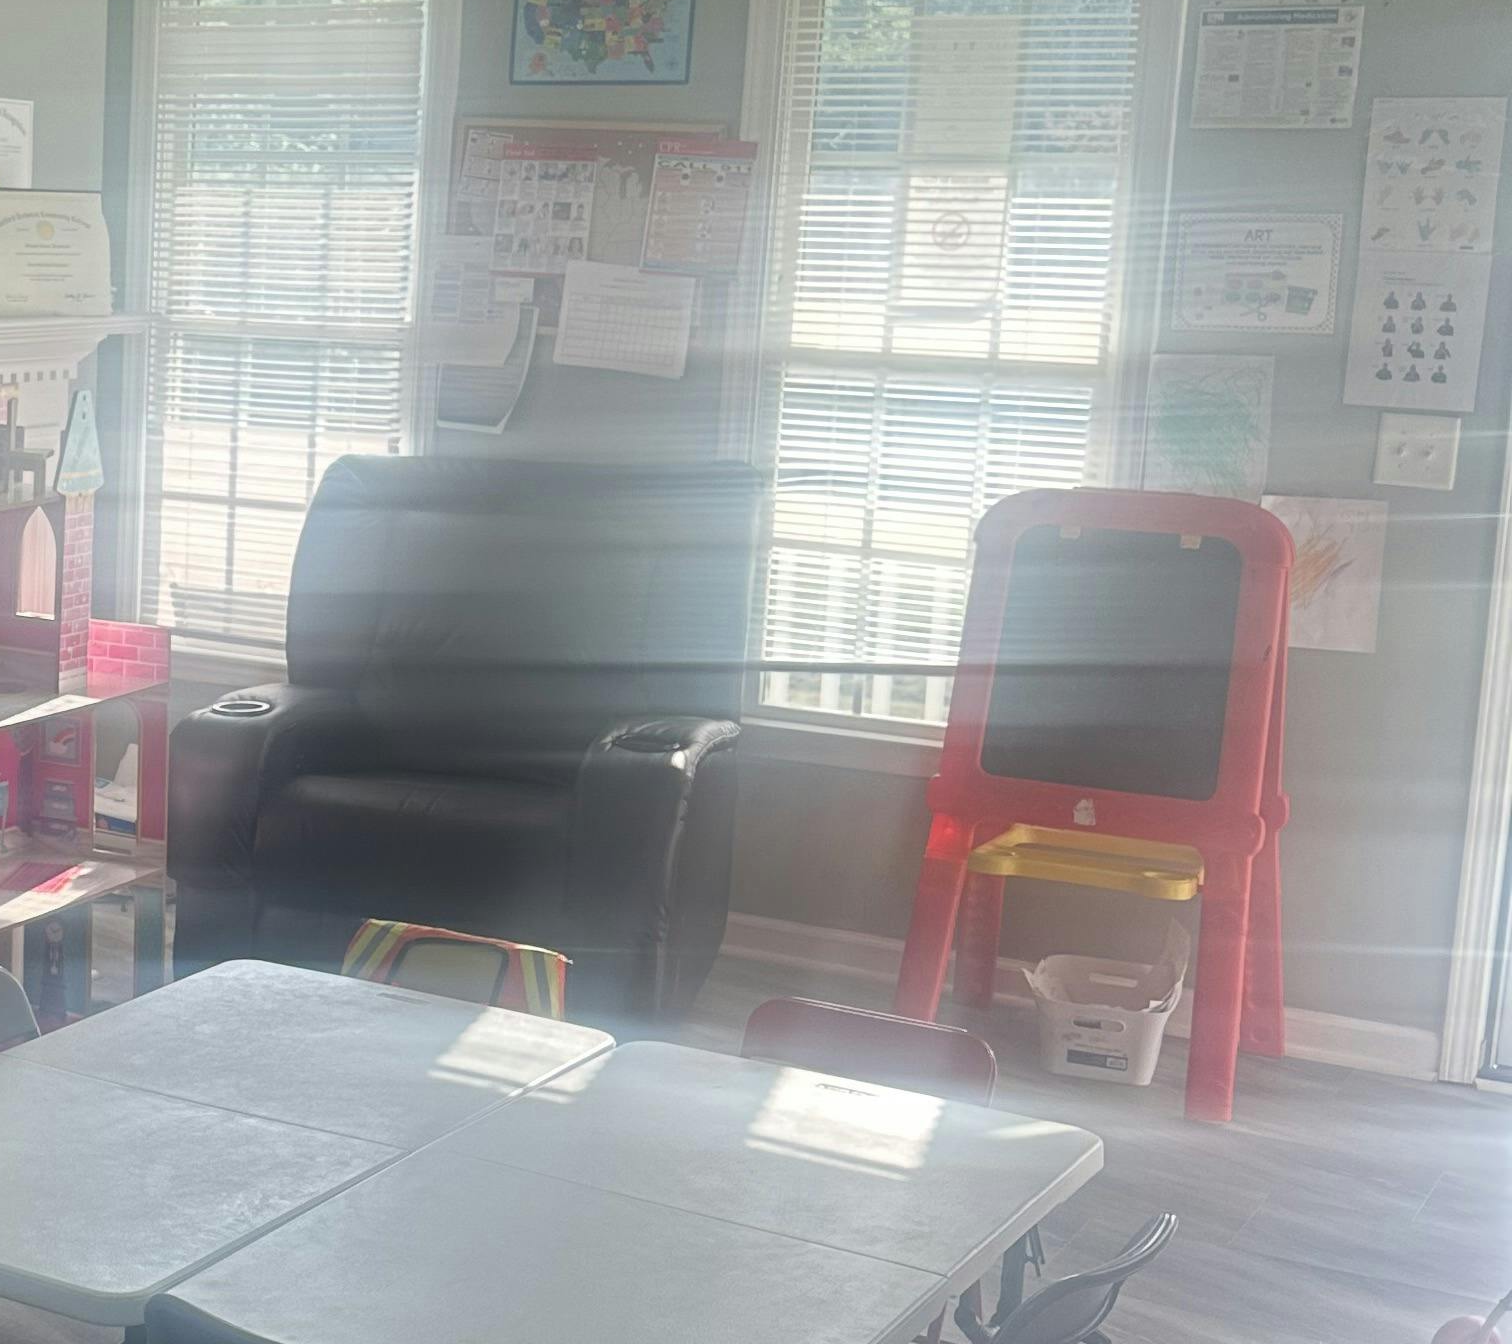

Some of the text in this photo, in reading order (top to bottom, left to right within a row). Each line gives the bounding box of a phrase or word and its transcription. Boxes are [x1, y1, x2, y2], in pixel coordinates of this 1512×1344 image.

[659, 141, 681, 153] CPR
[657, 159, 711, 171] CALL
[1244, 228, 1273, 242] ART
